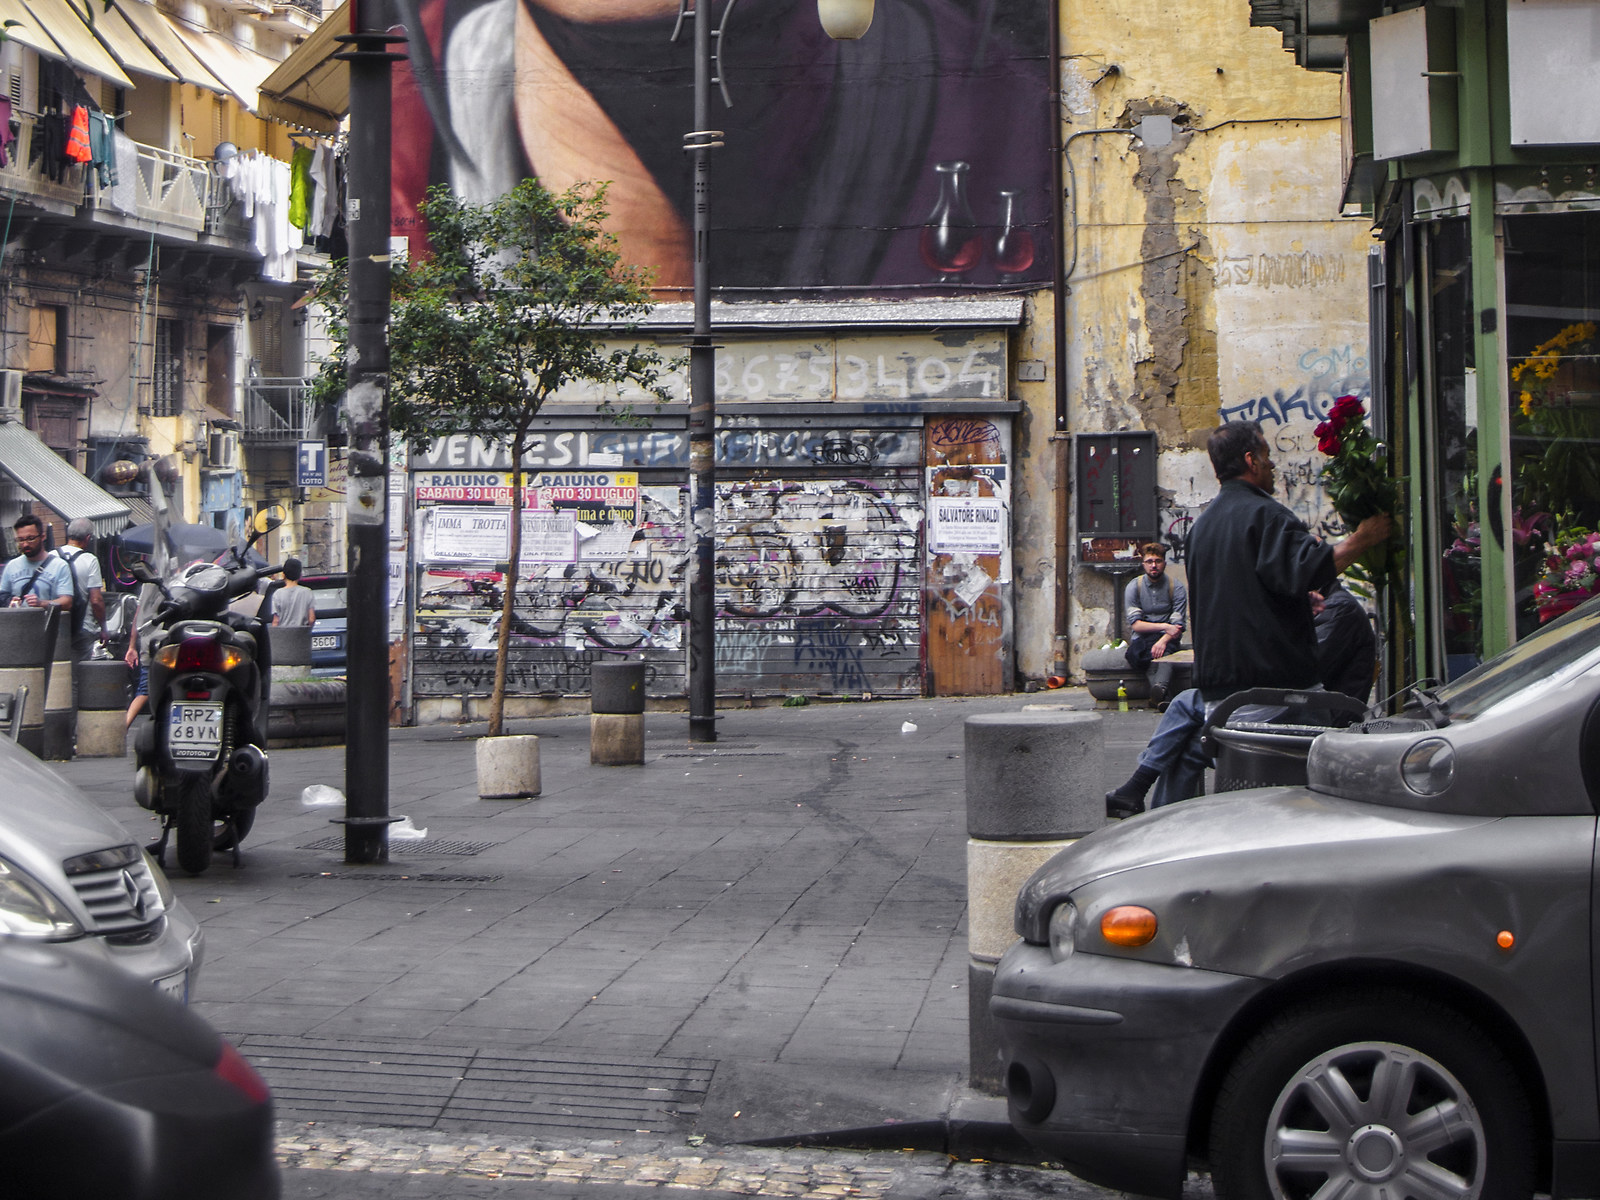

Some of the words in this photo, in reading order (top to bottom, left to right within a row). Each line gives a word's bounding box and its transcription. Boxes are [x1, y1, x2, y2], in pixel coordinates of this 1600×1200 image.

[424, 431, 589, 467] VENESI
[432, 474, 499, 487] RAIUNO
[541, 474, 609, 487] RAIUNO
[420, 487, 464, 500] SABATO
[466, 487, 481, 500] 30
[484, 487, 525, 500] LUGL
[577, 487, 592, 500] 30
[595, 487, 635, 500] LUGLIO
[599, 510, 606, 521] e
[939, 508, 974, 523] SALVATORE
[975, 508, 1000, 523] RINALDI
[438, 517, 462, 530] IMMA
[472, 517, 507, 530] TROTTA
[183, 708, 215, 722] RPZ
[174, 725, 218, 740] 68VN
